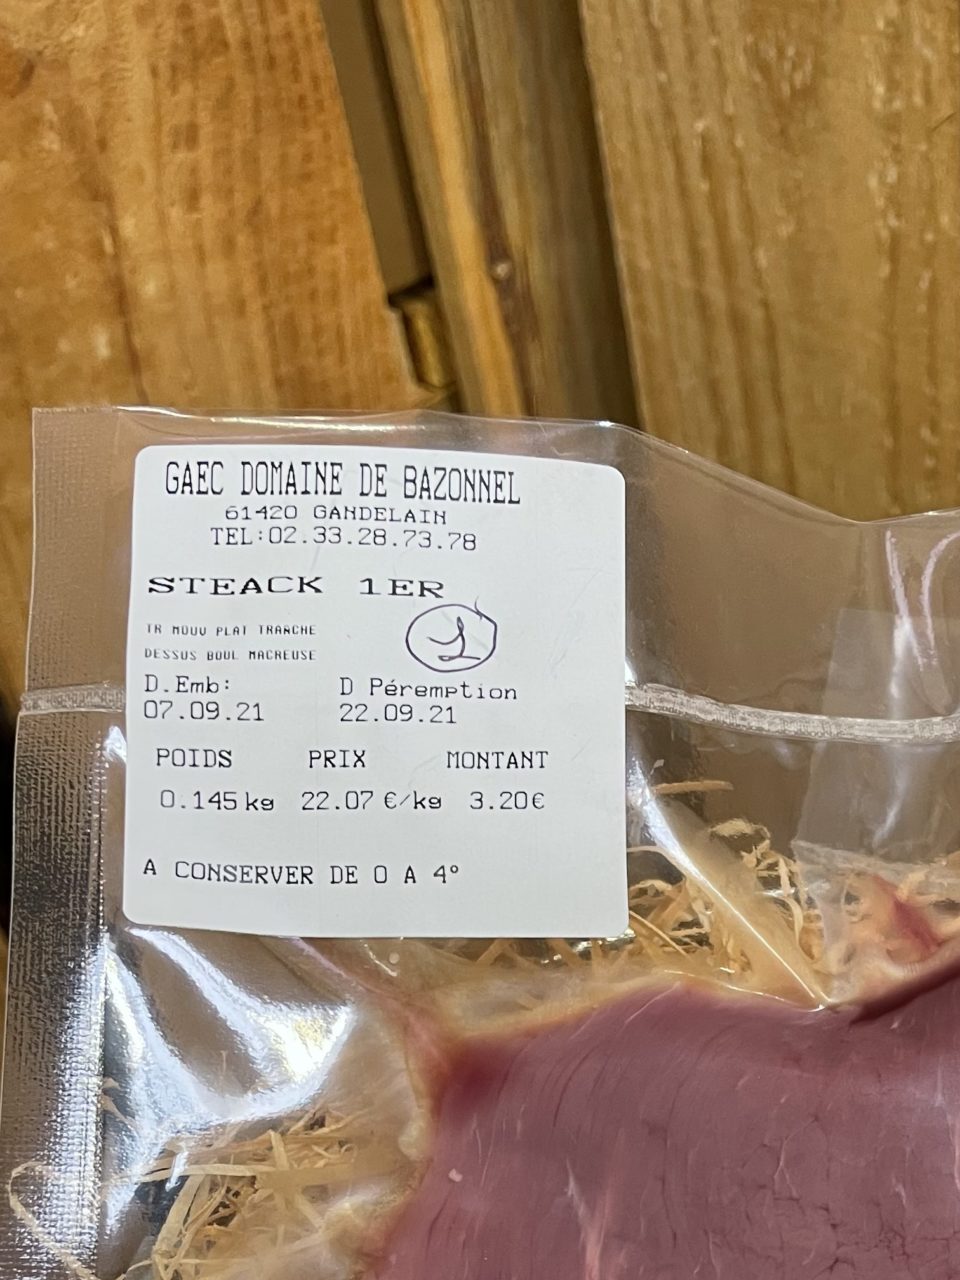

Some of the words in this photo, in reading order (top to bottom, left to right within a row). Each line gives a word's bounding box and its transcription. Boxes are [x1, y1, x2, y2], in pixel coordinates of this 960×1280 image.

[166, 461, 224, 496] GAEC
[240, 461, 343, 497] DOMAINE
[360, 463, 387, 498] DE
[403, 464, 521, 505] BAZONNEL
[225, 505, 298, 521] 61420
[313, 505, 447, 525] GANDELAIN
[147, 576, 324, 595] STEACK
[359, 577, 445, 599] 1ER
[144, 648, 197, 661] DESSUS
[207, 651, 239, 661] BOUL
[248, 650, 316, 661] MACREUSE
[340, 678, 353, 695] D
[369, 677, 518, 701] Péremption
[143, 701, 265, 723] 07.09.21
[339, 703, 457, 724] 22.09.21
[156, 748, 233, 769] POIDS
[309, 749, 367, 769] PRIX
[446, 750, 549, 770] MONTANT
[301, 790, 374, 810] 22.07
[469, 790, 545, 810] 3.20€
[143, 859, 157, 876] A
[174, 860, 314, 885] CONSERVER
[330, 865, 359, 885] DE
[404, 865, 417, 884] A
